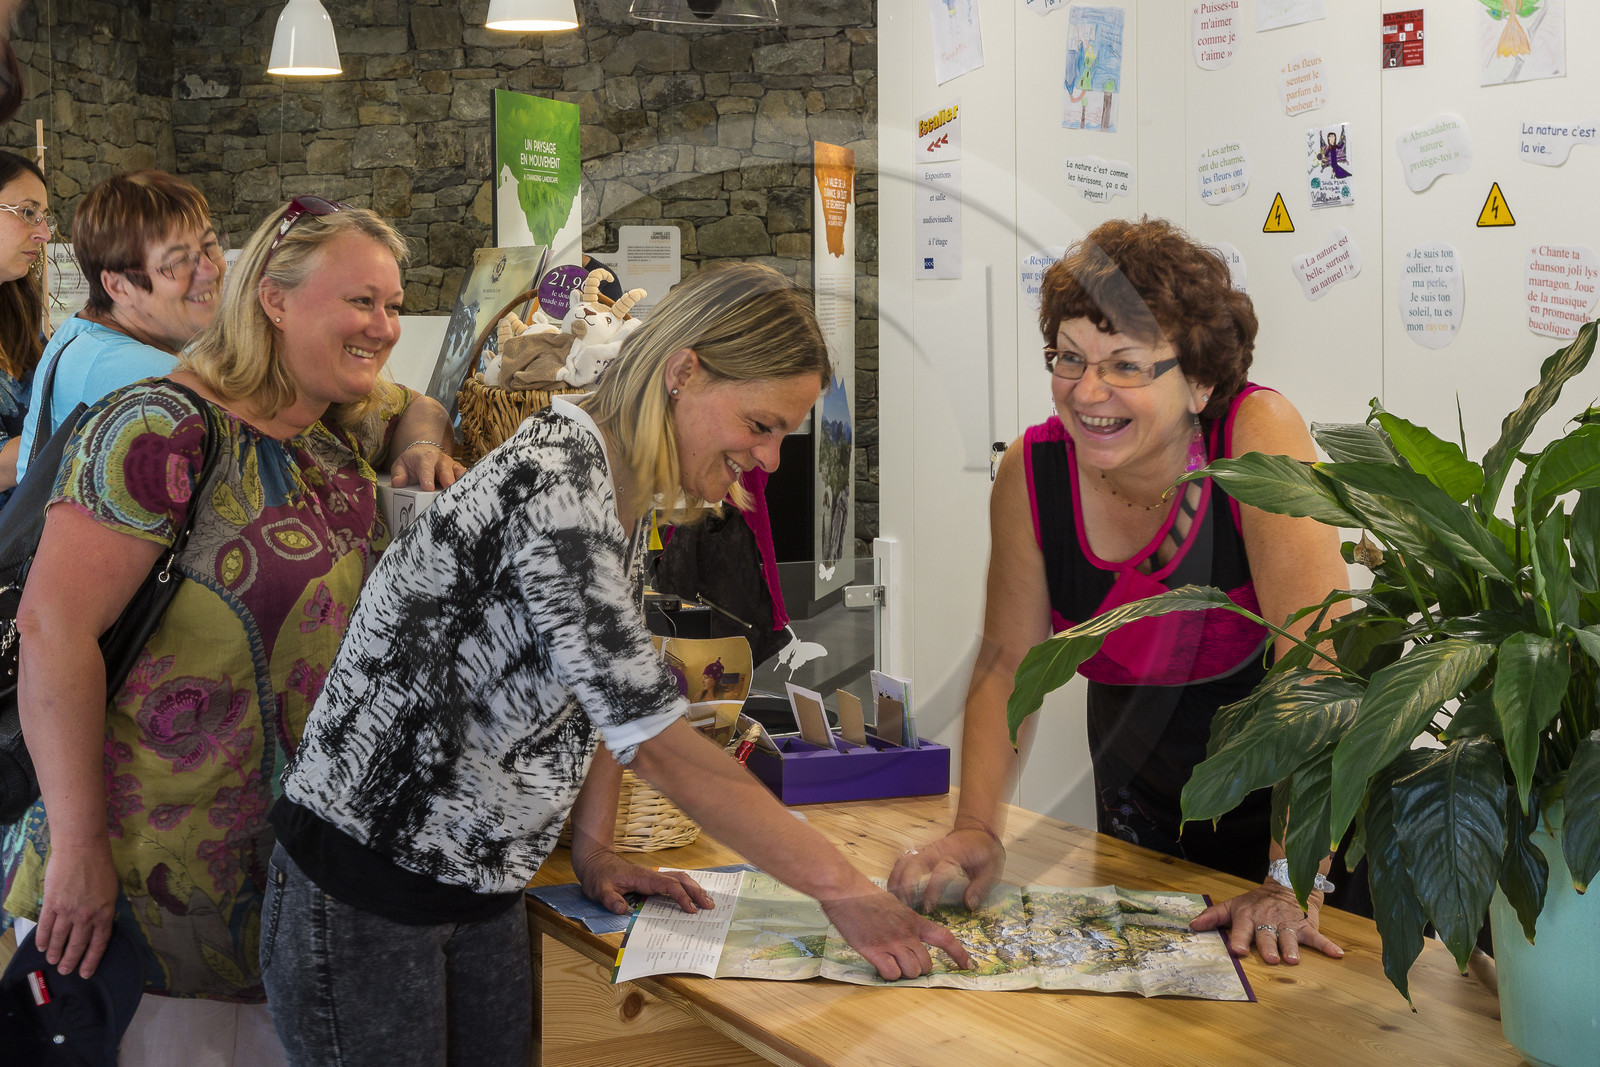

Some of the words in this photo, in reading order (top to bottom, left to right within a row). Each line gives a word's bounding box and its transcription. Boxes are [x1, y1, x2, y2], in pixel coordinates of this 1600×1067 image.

[1201, 1, 1239, 14] Puisses-tu
[1384, 9, 1424, 21] EXTINCTEUR
[1201, 17, 1232, 30] m'aimer
[1198, 34, 1227, 46] comme
[1228, 31, 1236, 45] je
[1201, 49, 1226, 61] t'aime
[1287, 63, 1301, 73] Les
[1302, 57, 1322, 69] fleurs
[1286, 73, 1311, 86] sentent
[1312, 70, 1320, 80] le
[1287, 88, 1312, 103] parfum
[1313, 83, 1322, 93] du
[1286, 101, 1313, 115] bonheur
[918, 104, 959, 138] Escalier
[1522, 122, 1534, 135] La
[1536, 125, 1568, 137] nature
[1571, 125, 1596, 138] c'est
[524, 139, 533, 151] UN
[533, 140, 557, 155] PAYSAGE
[1207, 149, 1219, 158] Les
[1220, 144, 1240, 154] arbres
[1420, 140, 1443, 153] nature
[1520, 141, 1530, 153] la
[520, 153, 528, 165] EN
[529, 154, 560, 169] MOUVEMENT
[1199, 163, 1209, 173] ont
[1210, 161, 1219, 170] du
[1409, 150, 1453, 174] protège-toi
[924, 171, 952, 181] Expositions
[1066, 160, 1074, 168] La
[1074, 163, 1092, 172] nature
[1093, 165, 1108, 174] c'est
[1109, 169, 1129, 179] comme
[1067, 172, 1076, 181] les
[1077, 174, 1103, 188] hérissons,
[1106, 181, 1113, 190] ça
[1120, 182, 1128, 191] du
[1202, 176, 1212, 185] les
[1213, 172, 1232, 182] fleurs
[1233, 169, 1243, 178] ont
[929, 194, 935, 202] et
[935, 193, 946, 201] salle
[1083, 189, 1104, 199] piquant
[1202, 189, 1213, 198] des
[1213, 183, 1241, 195] couleurs
[922, 215, 953, 224] audiovisuelle
[932, 238, 948, 247] l'étage
[1232, 252, 1240, 264] la
[1305, 258, 1316, 267] La
[1316, 243, 1338, 261] nature
[1338, 236, 1349, 247] est
[1413, 249, 1422, 259] Je
[1423, 248, 1439, 259] suis
[1441, 250, 1454, 258] ton
[1539, 246, 1570, 259] Chante
[1572, 250, 1580, 260] ta
[1305, 267, 1326, 281] belle,
[1325, 250, 1350, 270] surtout
[1406, 263, 1434, 274] collier,
[1436, 265, 1443, 273] tu
[1529, 260, 1565, 274] chanson
[1566, 264, 1582, 277] joli
[1585, 266, 1598, 279] lys
[1310, 285, 1320, 295] au
[1320, 267, 1344, 289] naturel
[1426, 277, 1448, 290] perle,
[1528, 277, 1572, 291] martagon.
[1574, 281, 1595, 293] Joue
[541, 297, 558, 305] made
[1410, 292, 1419, 302] Je
[1420, 292, 1436, 302] suis
[1438, 294, 1451, 302] ton
[1527, 290, 1538, 302] de
[1540, 292, 1548, 303] la
[1550, 295, 1588, 309] musique
[1408, 307, 1432, 317] soleil,
[1434, 308, 1442, 317] tu
[1530, 304, 1540, 314] en
[1542, 307, 1591, 324] promenade
[1407, 323, 1424, 331] mon
[1425, 323, 1449, 334] rayon
[1528, 317, 1571, 336] bucolique
